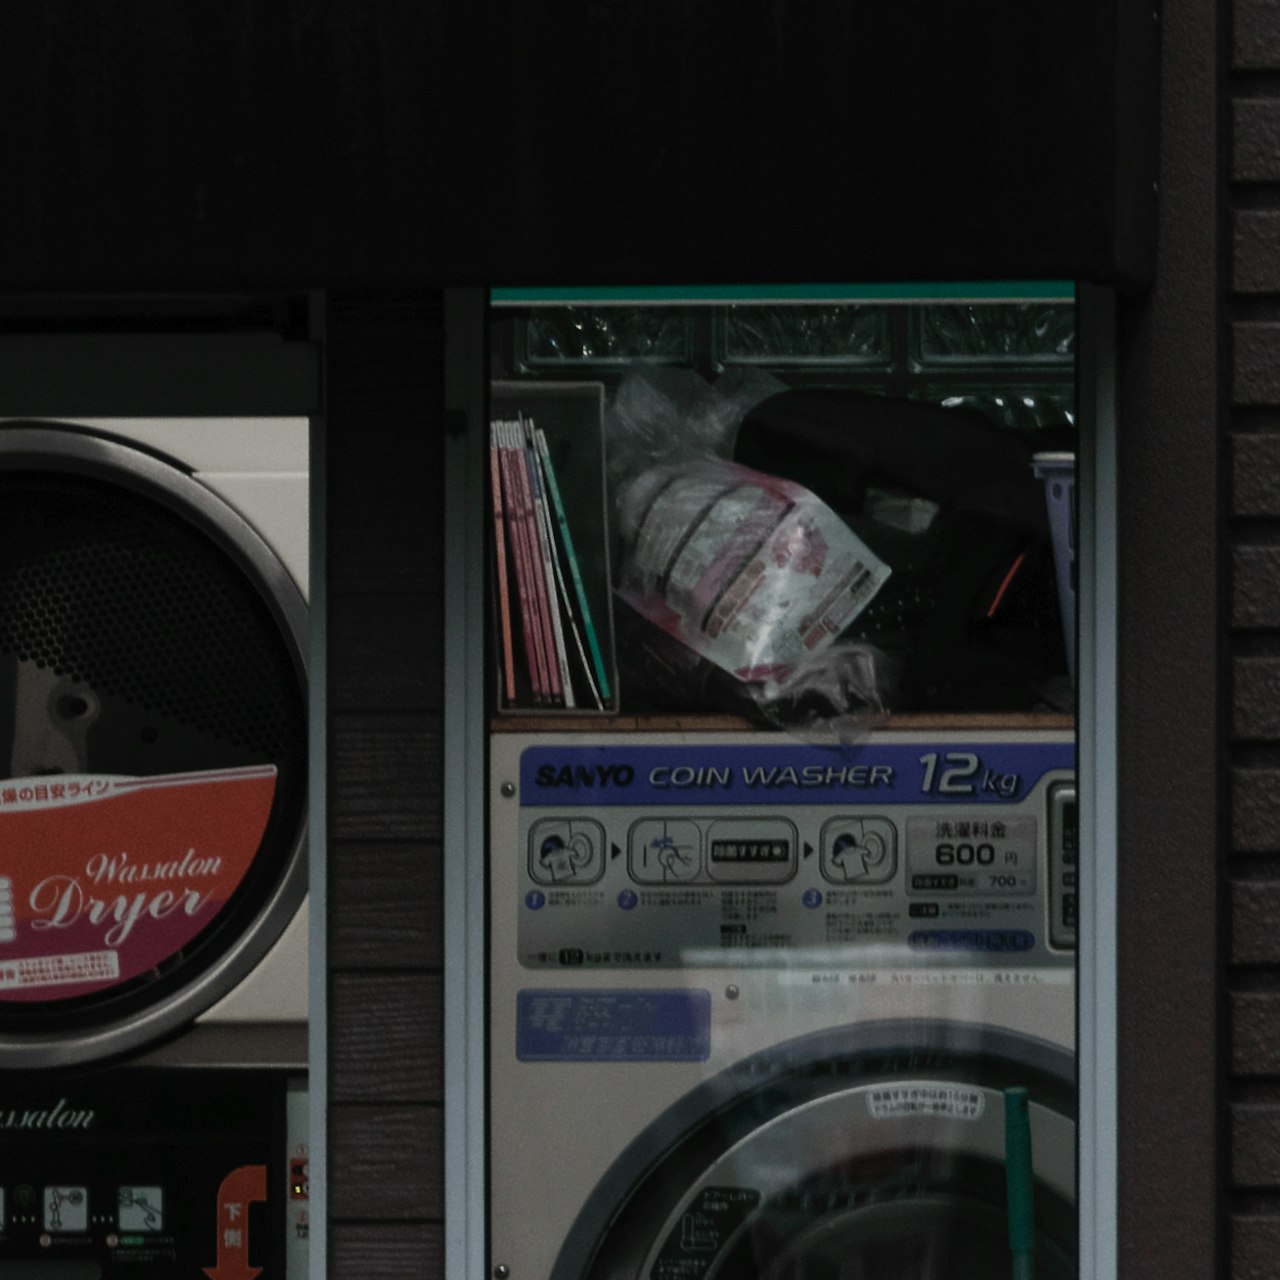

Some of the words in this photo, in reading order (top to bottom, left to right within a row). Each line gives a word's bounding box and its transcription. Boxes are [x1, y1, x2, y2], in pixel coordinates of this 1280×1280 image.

[536, 765, 634, 787] SANYO
[649, 766, 731, 786] COIN
[742, 765, 893, 786] WASHER
[936, 820, 1006, 838] 洗濯料金
[935, 843, 995, 865] 600
[85, 847, 222, 884] Wassalon
[991, 874, 1016, 886] 700
[29, 875, 214, 948] Dryer
